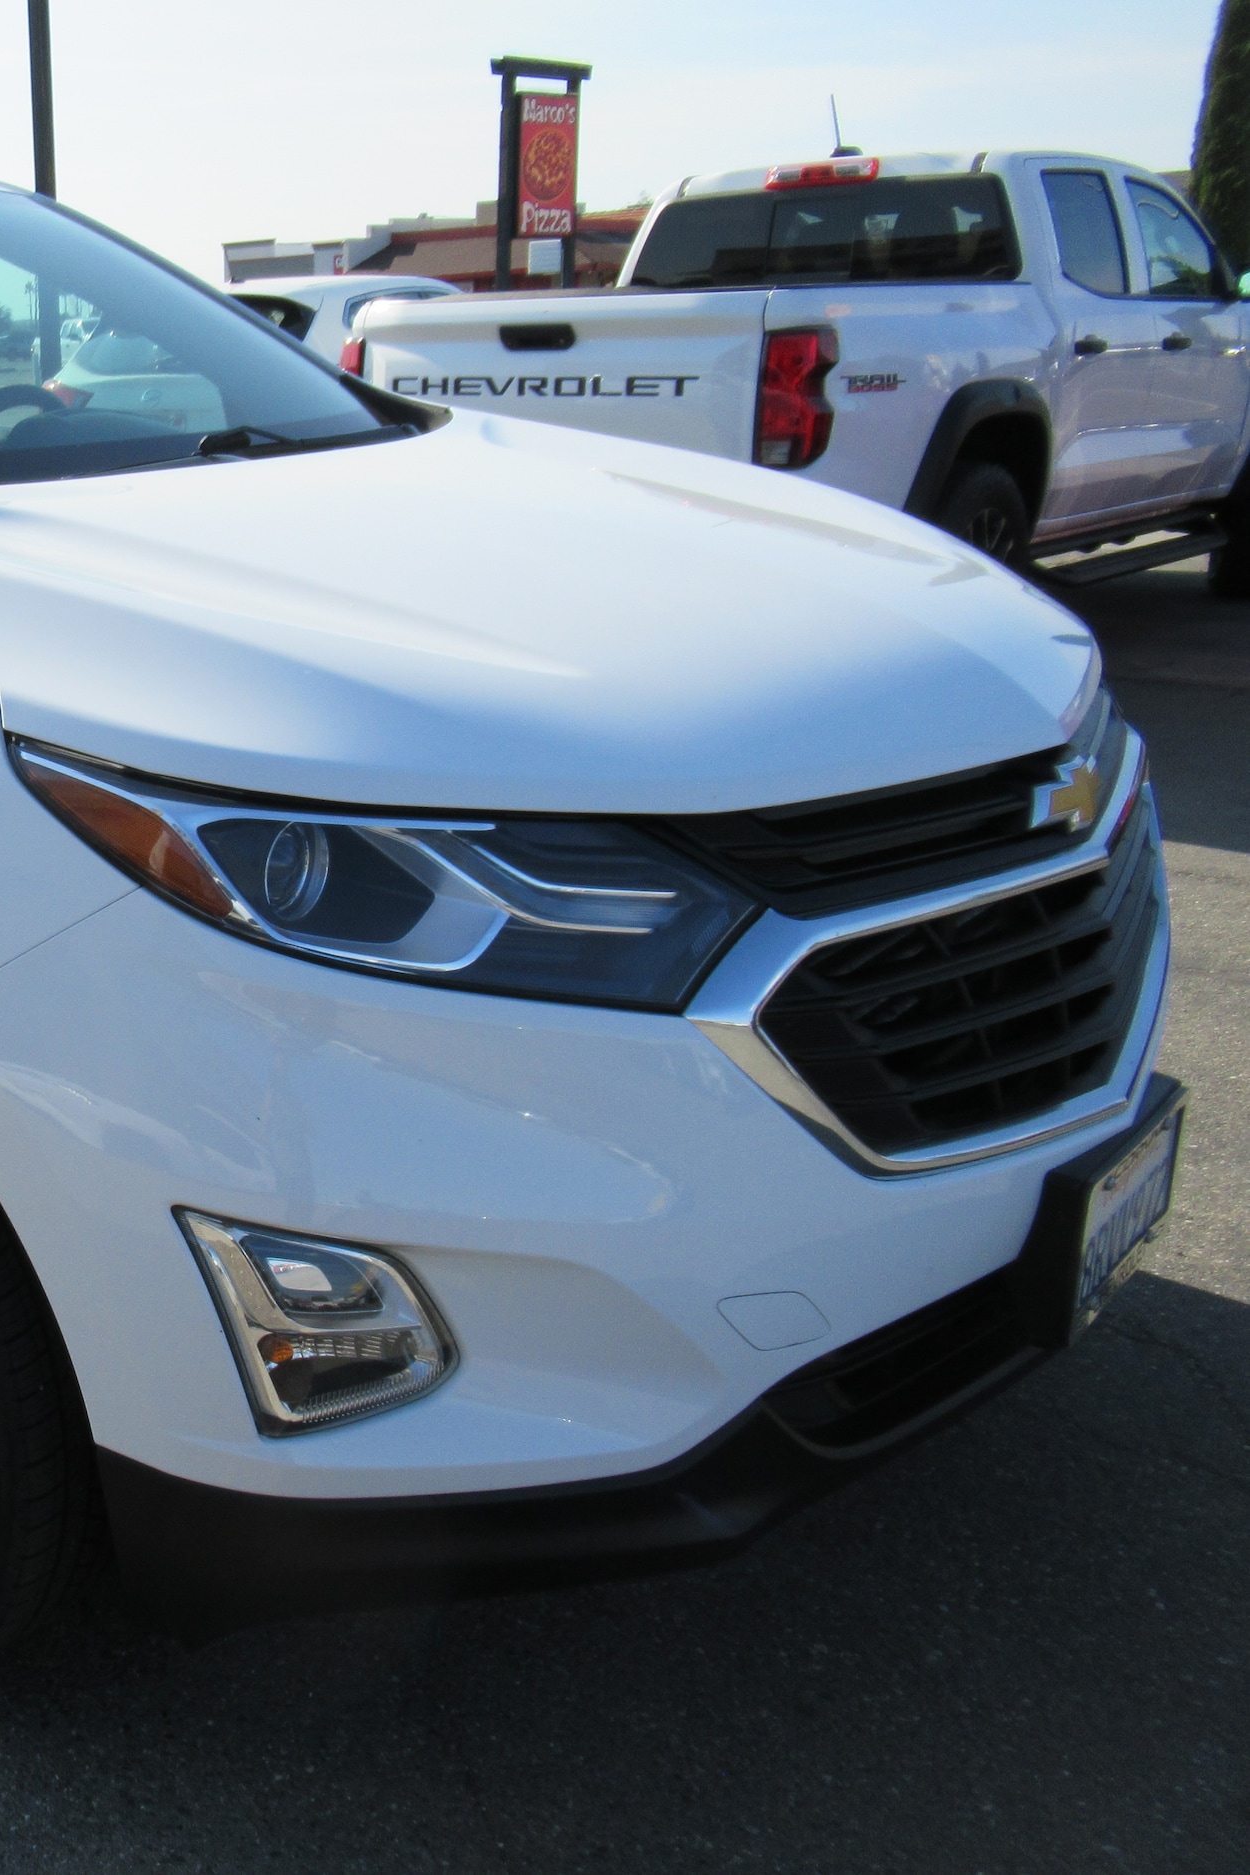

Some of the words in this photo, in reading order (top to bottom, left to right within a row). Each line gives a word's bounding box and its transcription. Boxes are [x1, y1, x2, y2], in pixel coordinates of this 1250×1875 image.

[522, 97, 576, 125] Marco's
[522, 202, 571, 235] Pizza
[392, 375, 700, 397] CHEVROLET
[840, 374, 906, 385] TRAIL
